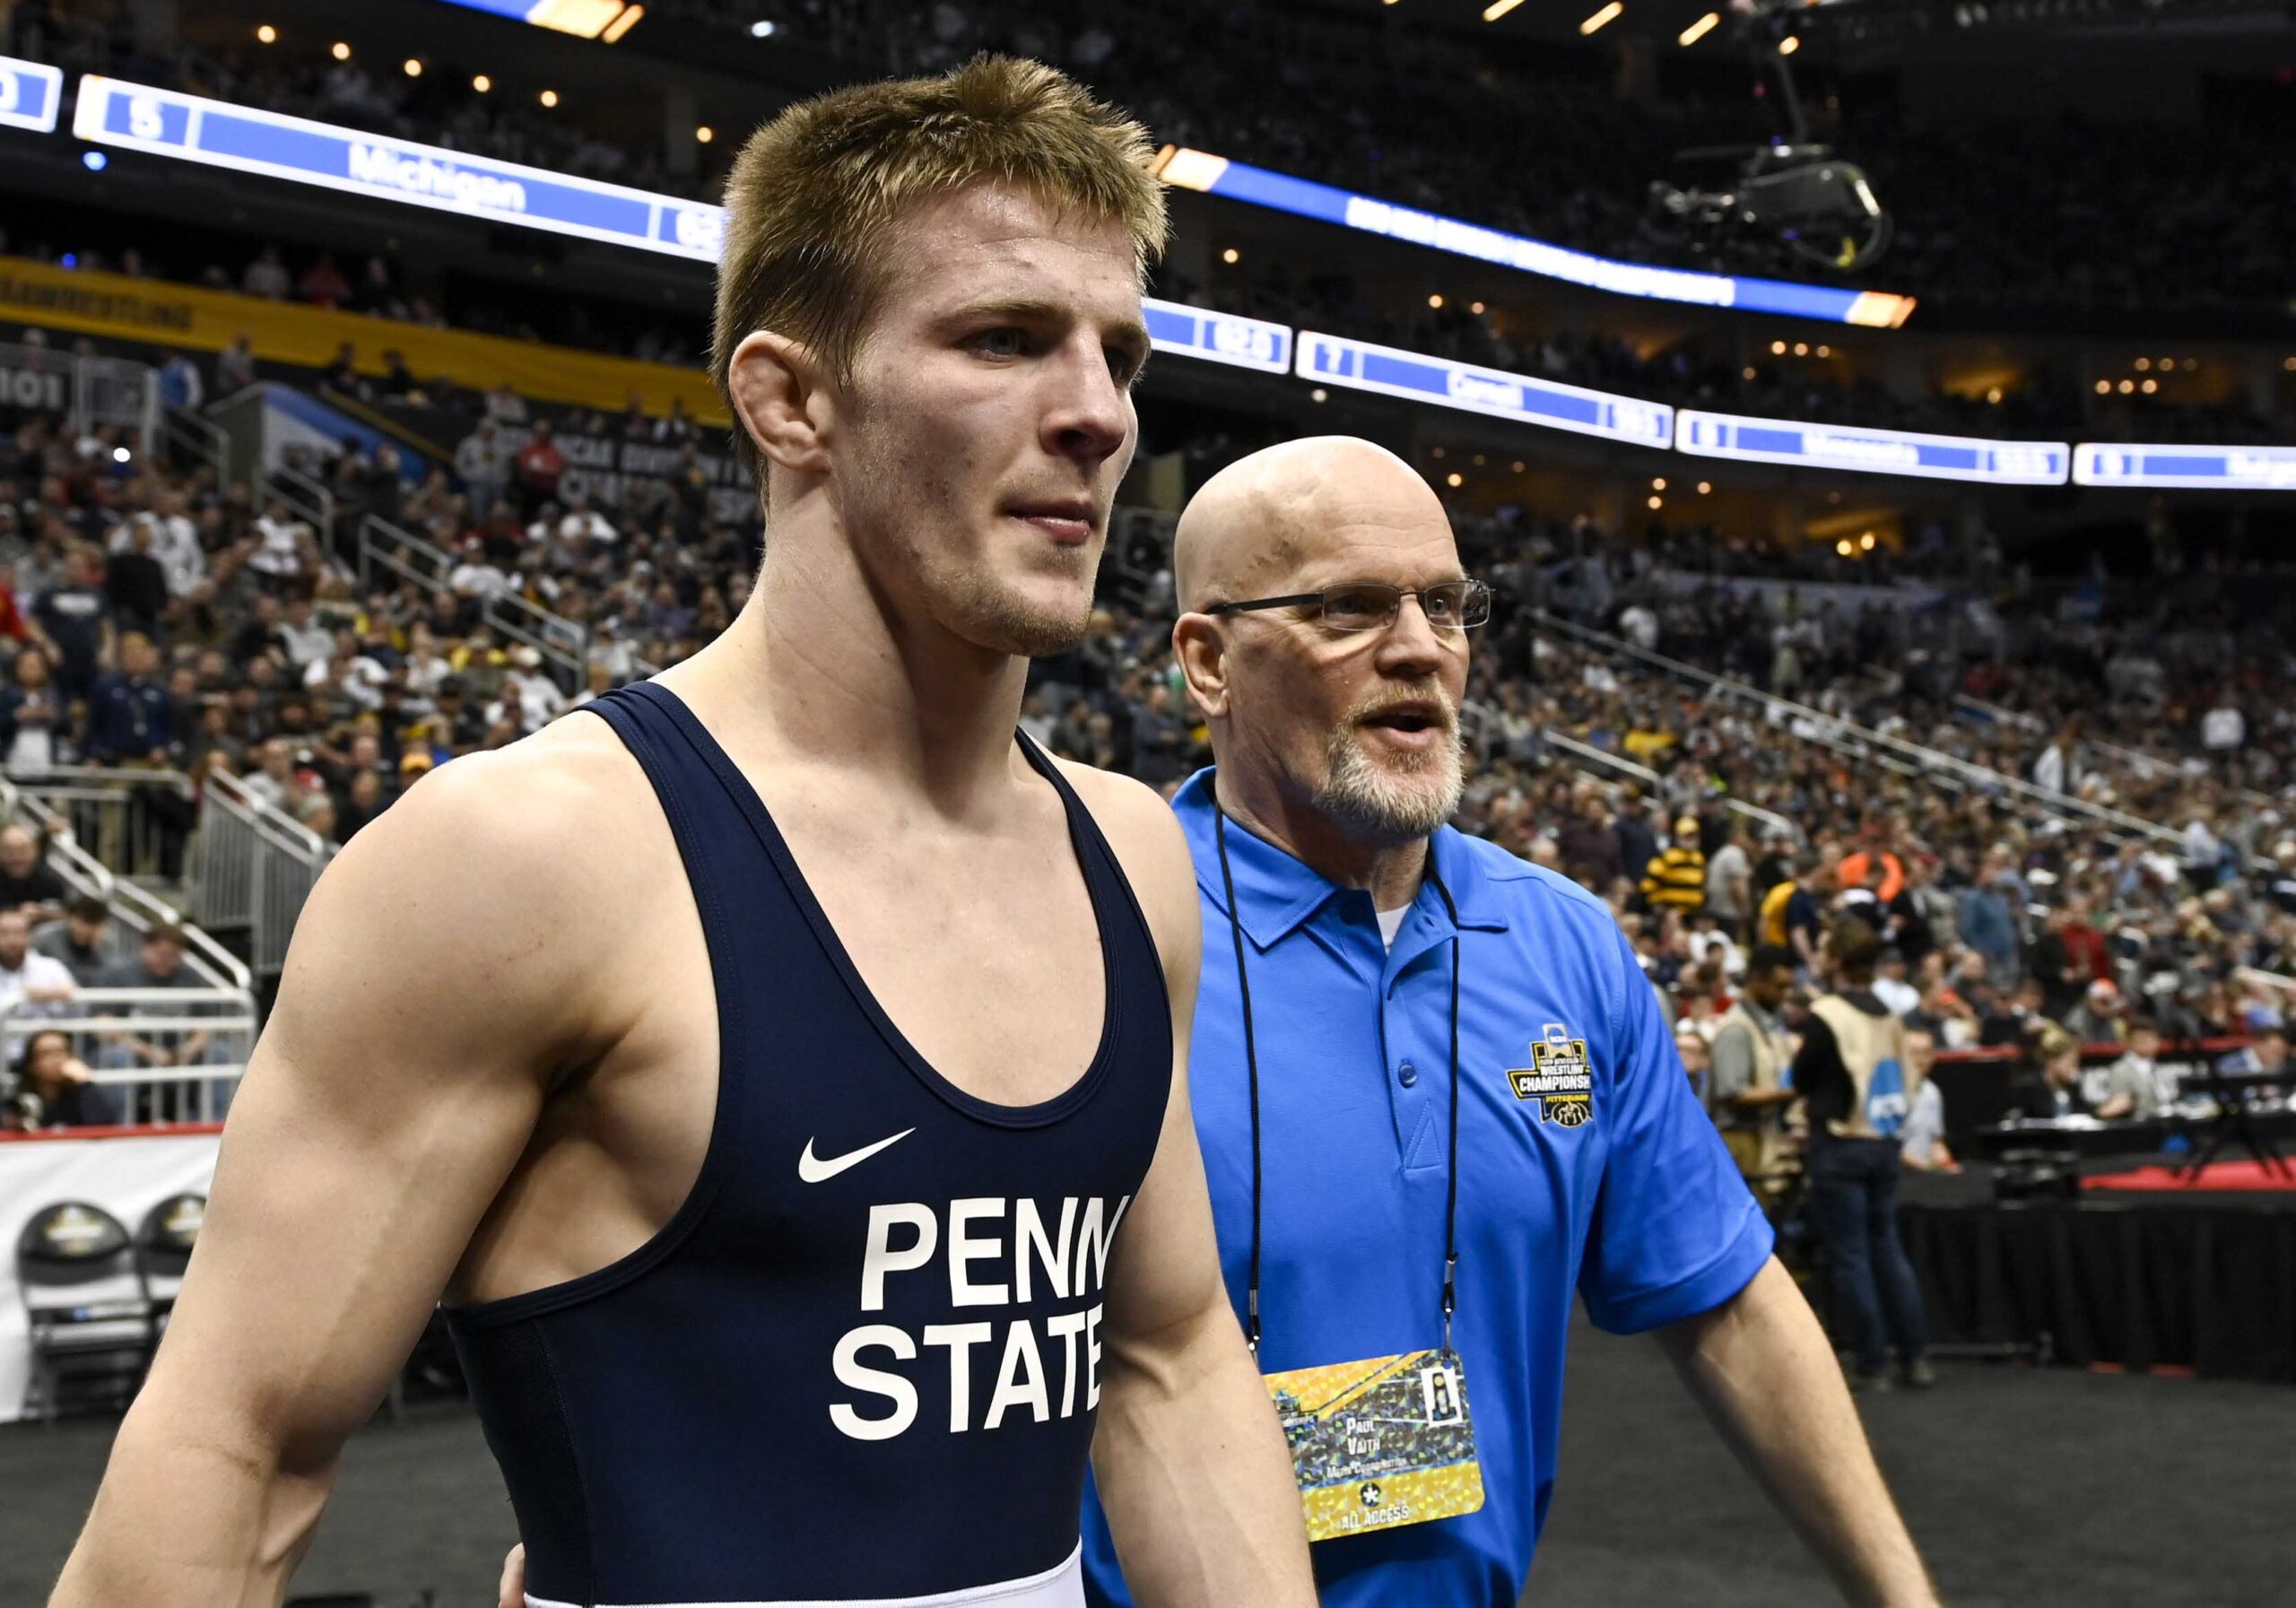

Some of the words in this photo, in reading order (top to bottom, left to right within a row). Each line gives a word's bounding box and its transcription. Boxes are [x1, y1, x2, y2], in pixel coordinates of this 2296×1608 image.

[348, 143, 526, 213] Michigan
[860, 1195, 1131, 1311] PENN
[829, 1302, 1103, 1440] STATE
[1363, 1506, 1410, 1525] ACCESS
